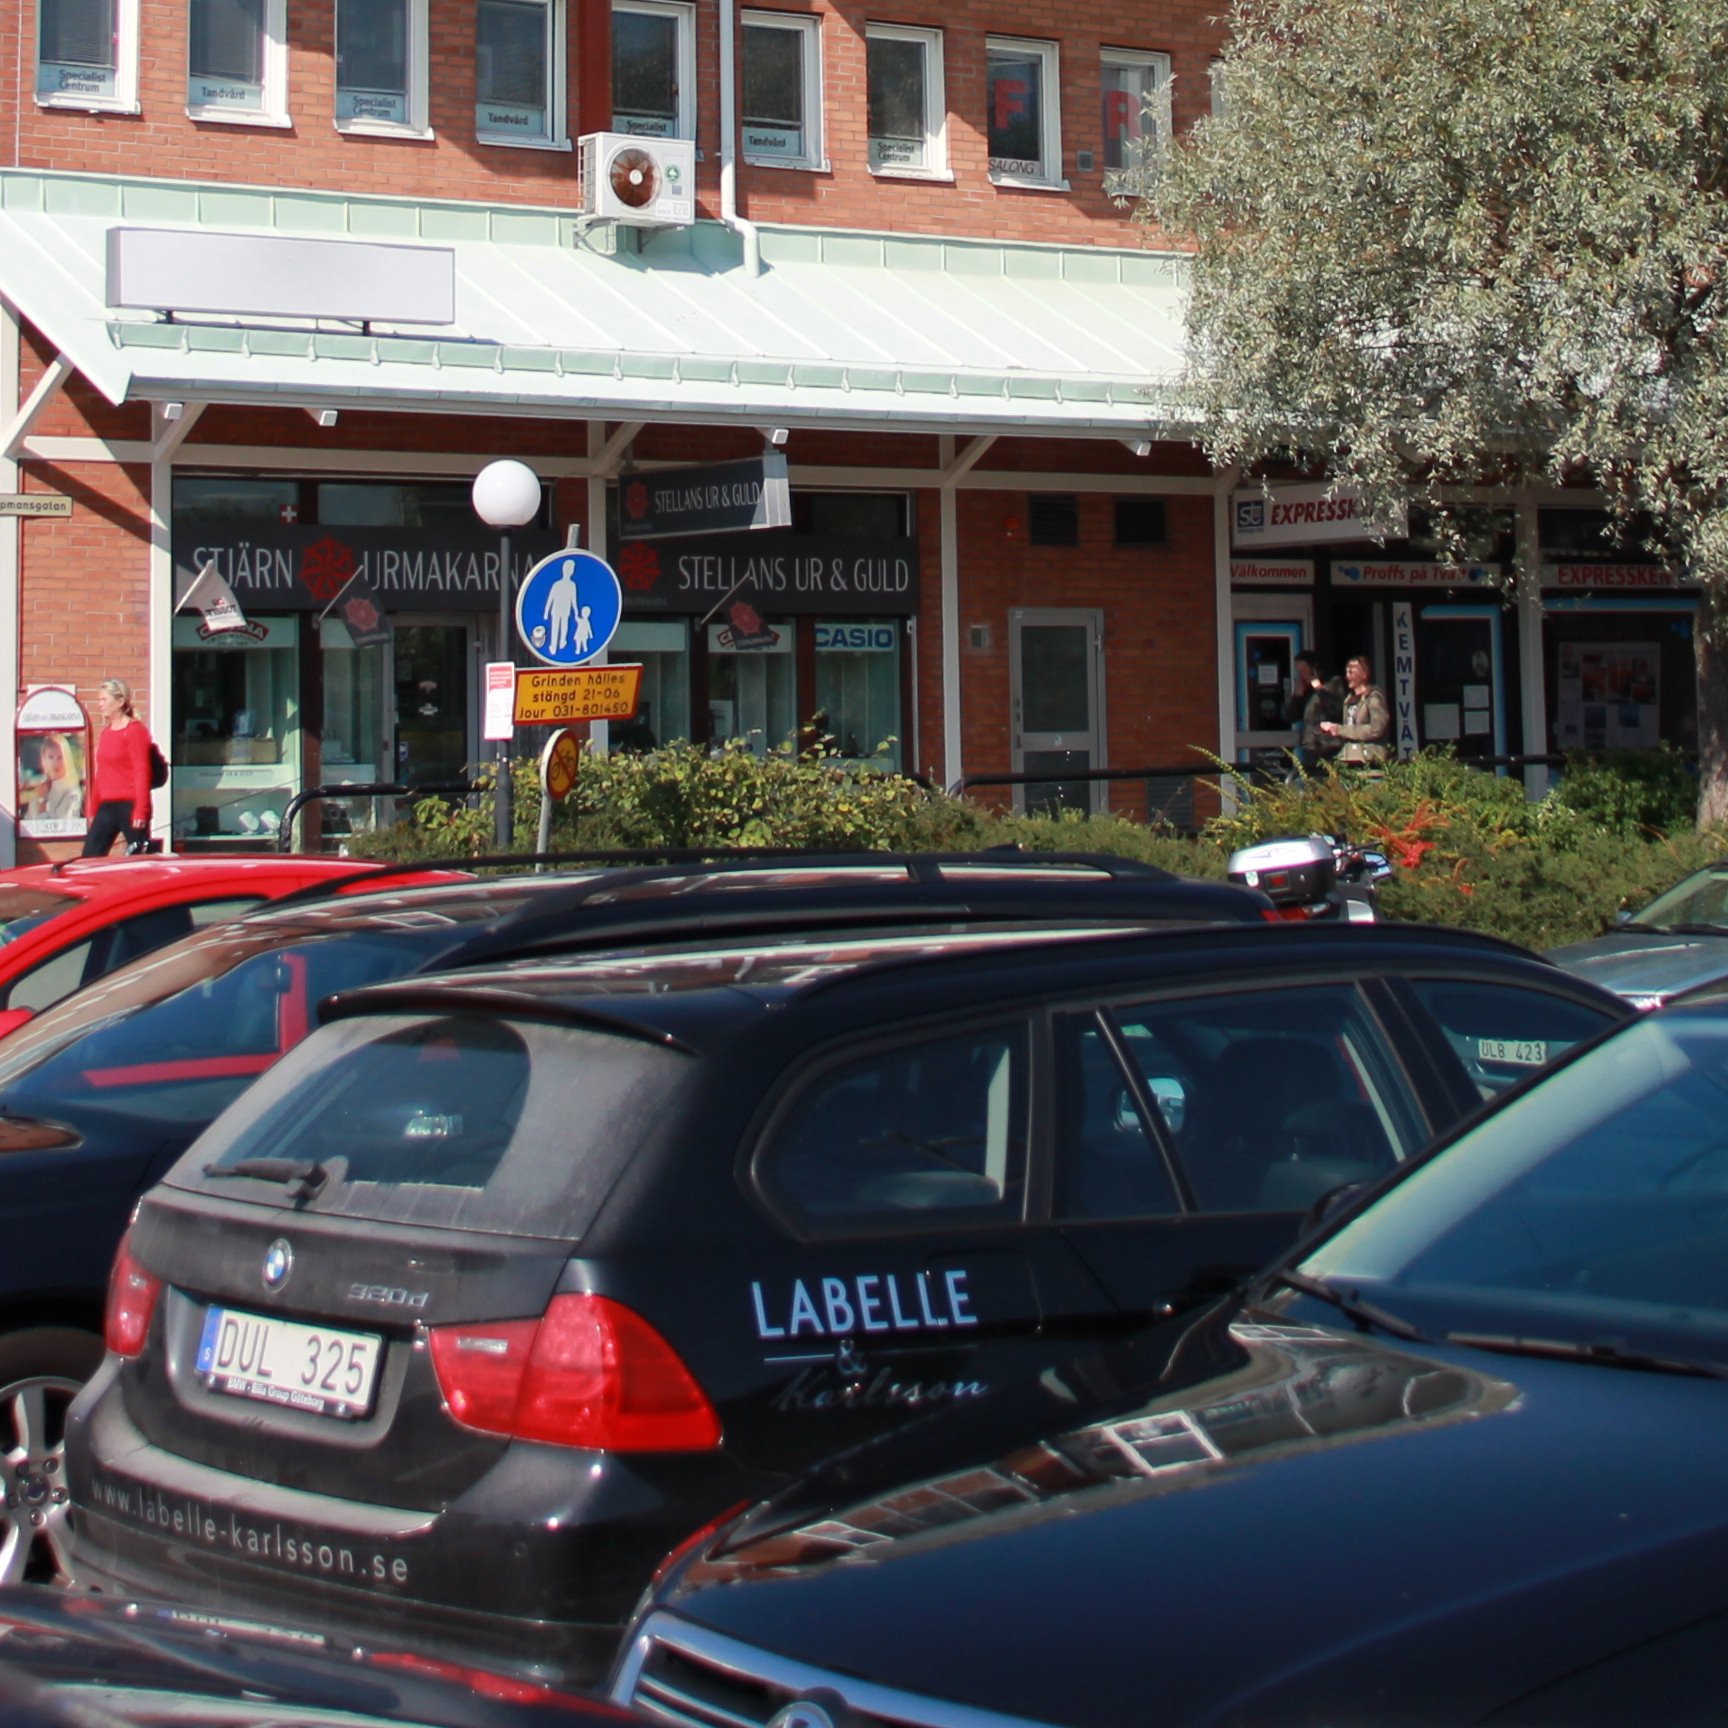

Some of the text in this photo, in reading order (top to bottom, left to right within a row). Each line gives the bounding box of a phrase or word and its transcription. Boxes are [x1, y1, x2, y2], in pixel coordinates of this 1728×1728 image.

[59, 69, 106, 82] Specialist
[59, 80, 100, 93] Centrum
[201, 86, 245, 100] Tandvård
[353, 95, 396, 108] Specialist
[353, 105, 391, 117] Centrum
[488, 112, 529, 125] Tandvård
[627, 120, 667, 132] Specialist
[749, 135, 786, 148] Tandvård
[877, 141, 915, 153] Specialist
[877, 151, 911, 163] Centrum
[988, 159, 1035, 175] SALONG
[655, 482, 760, 514] STELLANS UR & GULD
[1271, 498, 1362, 526] EXPRESSK
[193, 541, 294, 589] STJÄRN
[1231, 563, 1307, 579] Välkommen
[678, 555, 909, 593] STELLANS UR & GULD
[1363, 564, 1404, 580] Proffs
[1410, 565, 1428, 583] på
[815, 627, 894, 648] CASIO
[532, 673, 625, 688] Grinden hålles
[532, 688, 620, 704] stängd 21-06
[519, 703, 629, 719] Jour 031-801450
[1515, 1042, 1542, 1061] 423
[348, 1283, 429, 1308] 320d
[751, 1270, 978, 1338] LABELLE
[217, 1317, 368, 1394] DUL 325
[837, 1339, 867, 1374] &
[92, 1478, 408, 1581] www.labelle-karlsson.se
